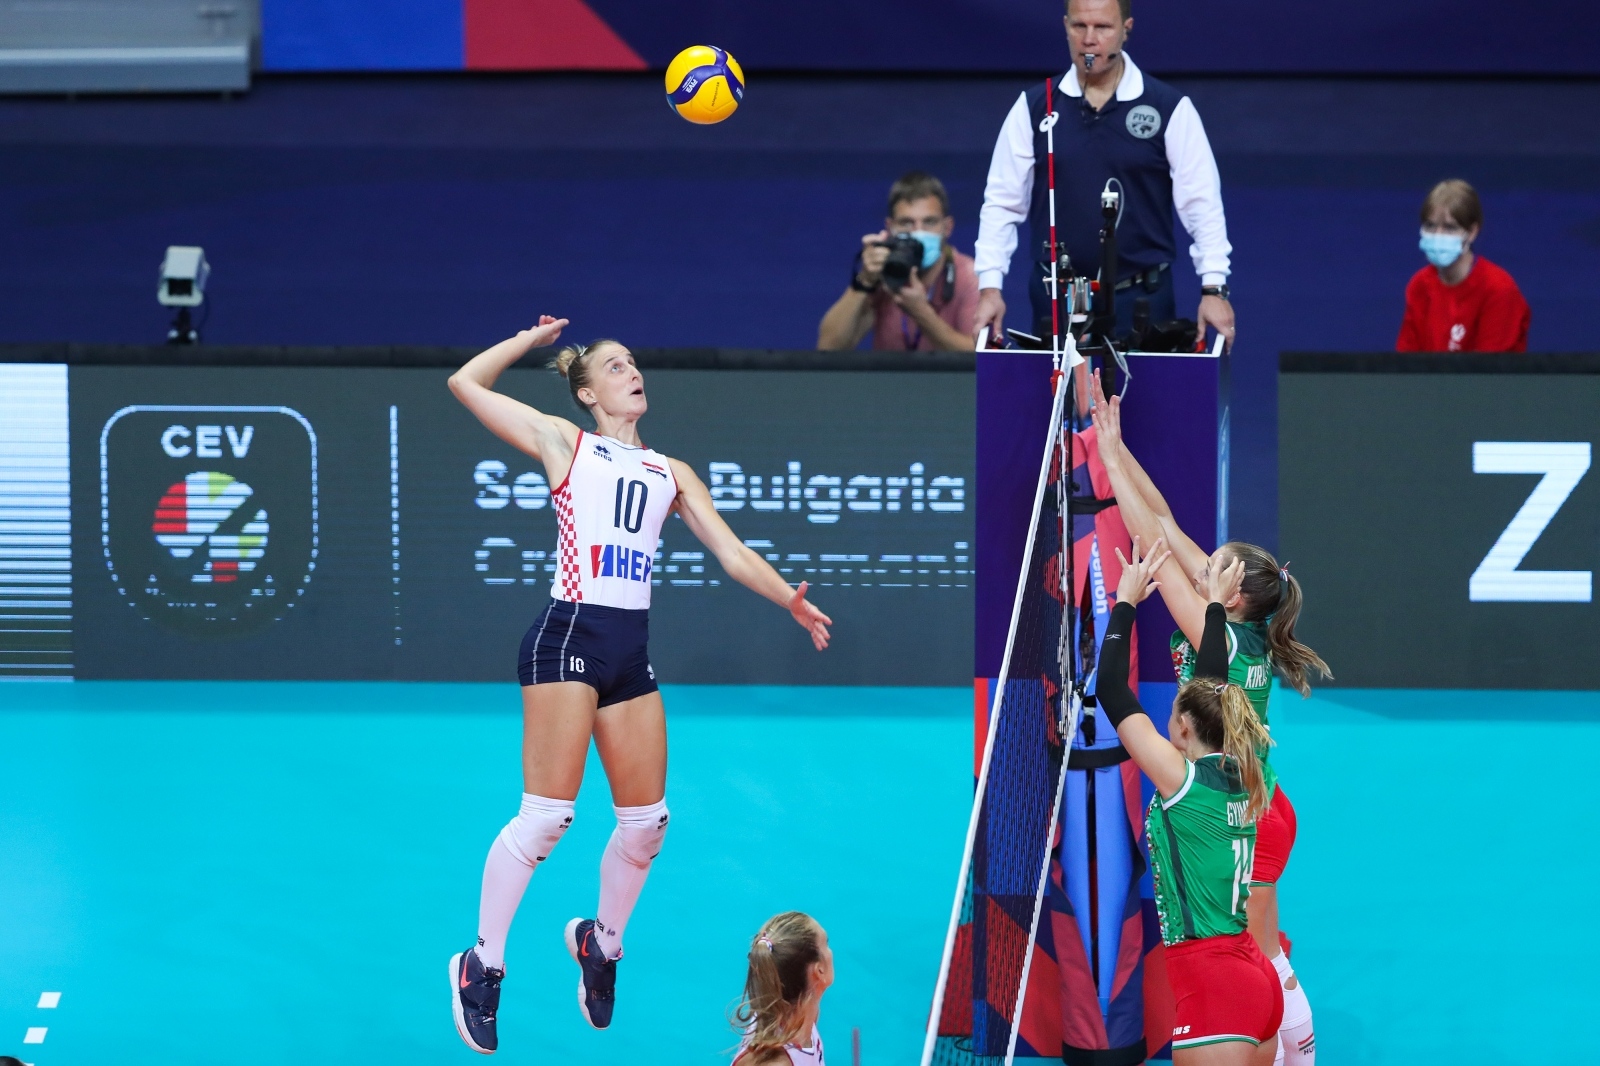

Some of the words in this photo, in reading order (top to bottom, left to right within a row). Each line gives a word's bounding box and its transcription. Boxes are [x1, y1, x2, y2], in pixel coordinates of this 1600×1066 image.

[161, 425, 254, 458] CEV
[614, 476, 648, 534] 10
[708, 461, 966, 524] Bulgaria
[1469, 441, 1593, 602] Z
[569, 655, 585, 674] 10
[1231, 837, 1256, 916] 14
